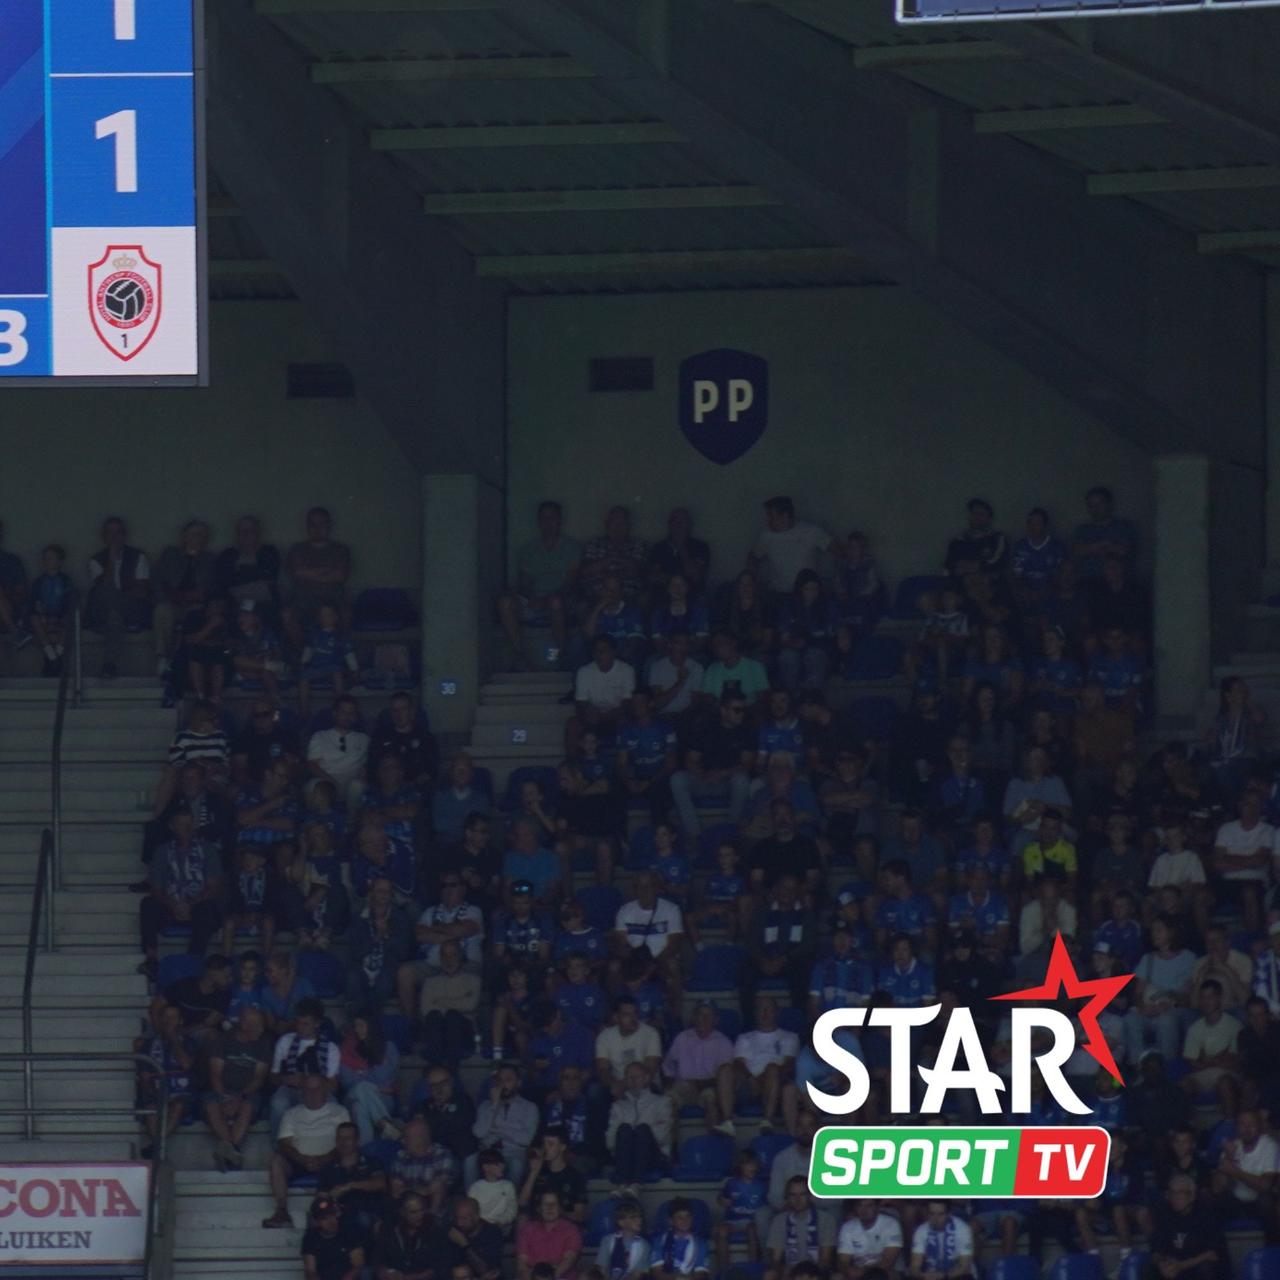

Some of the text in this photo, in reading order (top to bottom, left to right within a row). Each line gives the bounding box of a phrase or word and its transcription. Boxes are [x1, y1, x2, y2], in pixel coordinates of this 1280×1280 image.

[95, 109, 138, 192] 1
[121, 333, 128, 349] 1
[694, 379, 754, 423] PP
